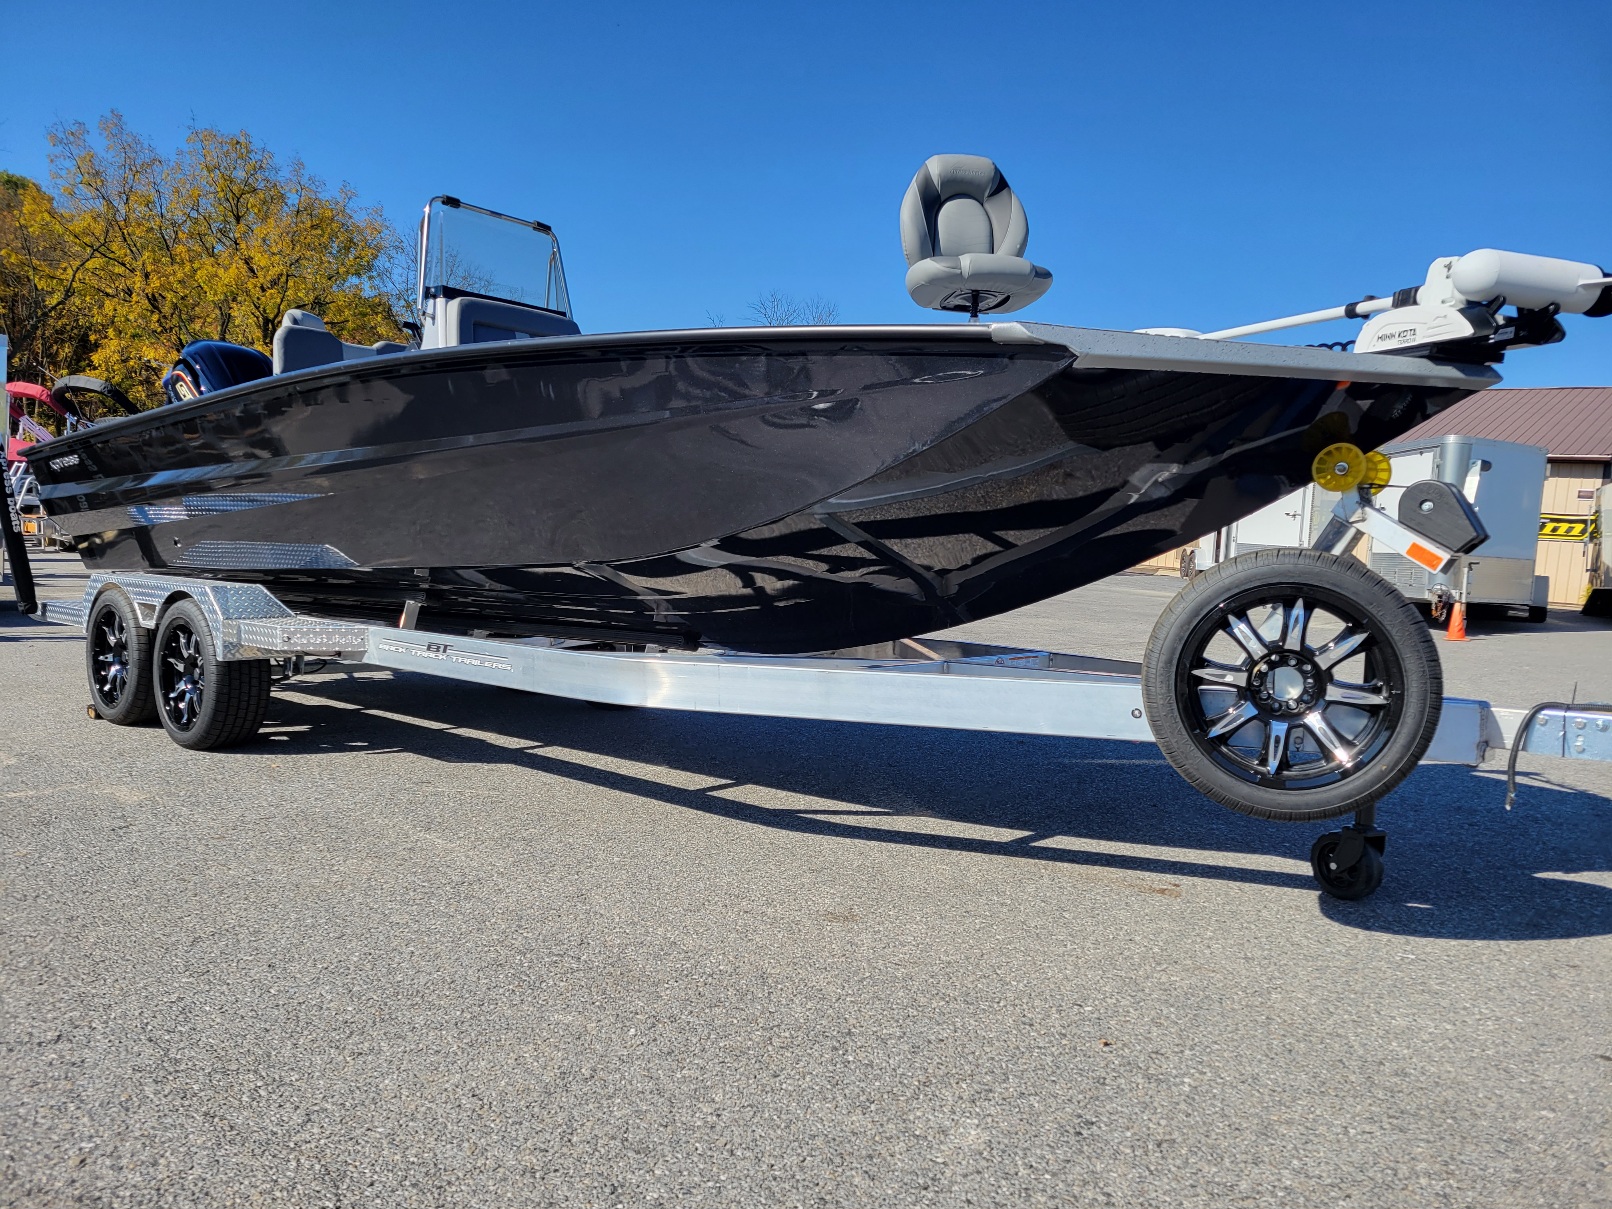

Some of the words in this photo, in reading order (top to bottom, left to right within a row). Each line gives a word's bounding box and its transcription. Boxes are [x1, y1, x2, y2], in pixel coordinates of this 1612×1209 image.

[1398, 328, 1417, 338] KOTA
[426, 641, 455, 654] BT
[410, 649, 449, 661] TRACK
[450, 656, 514, 672] TRAILERS
